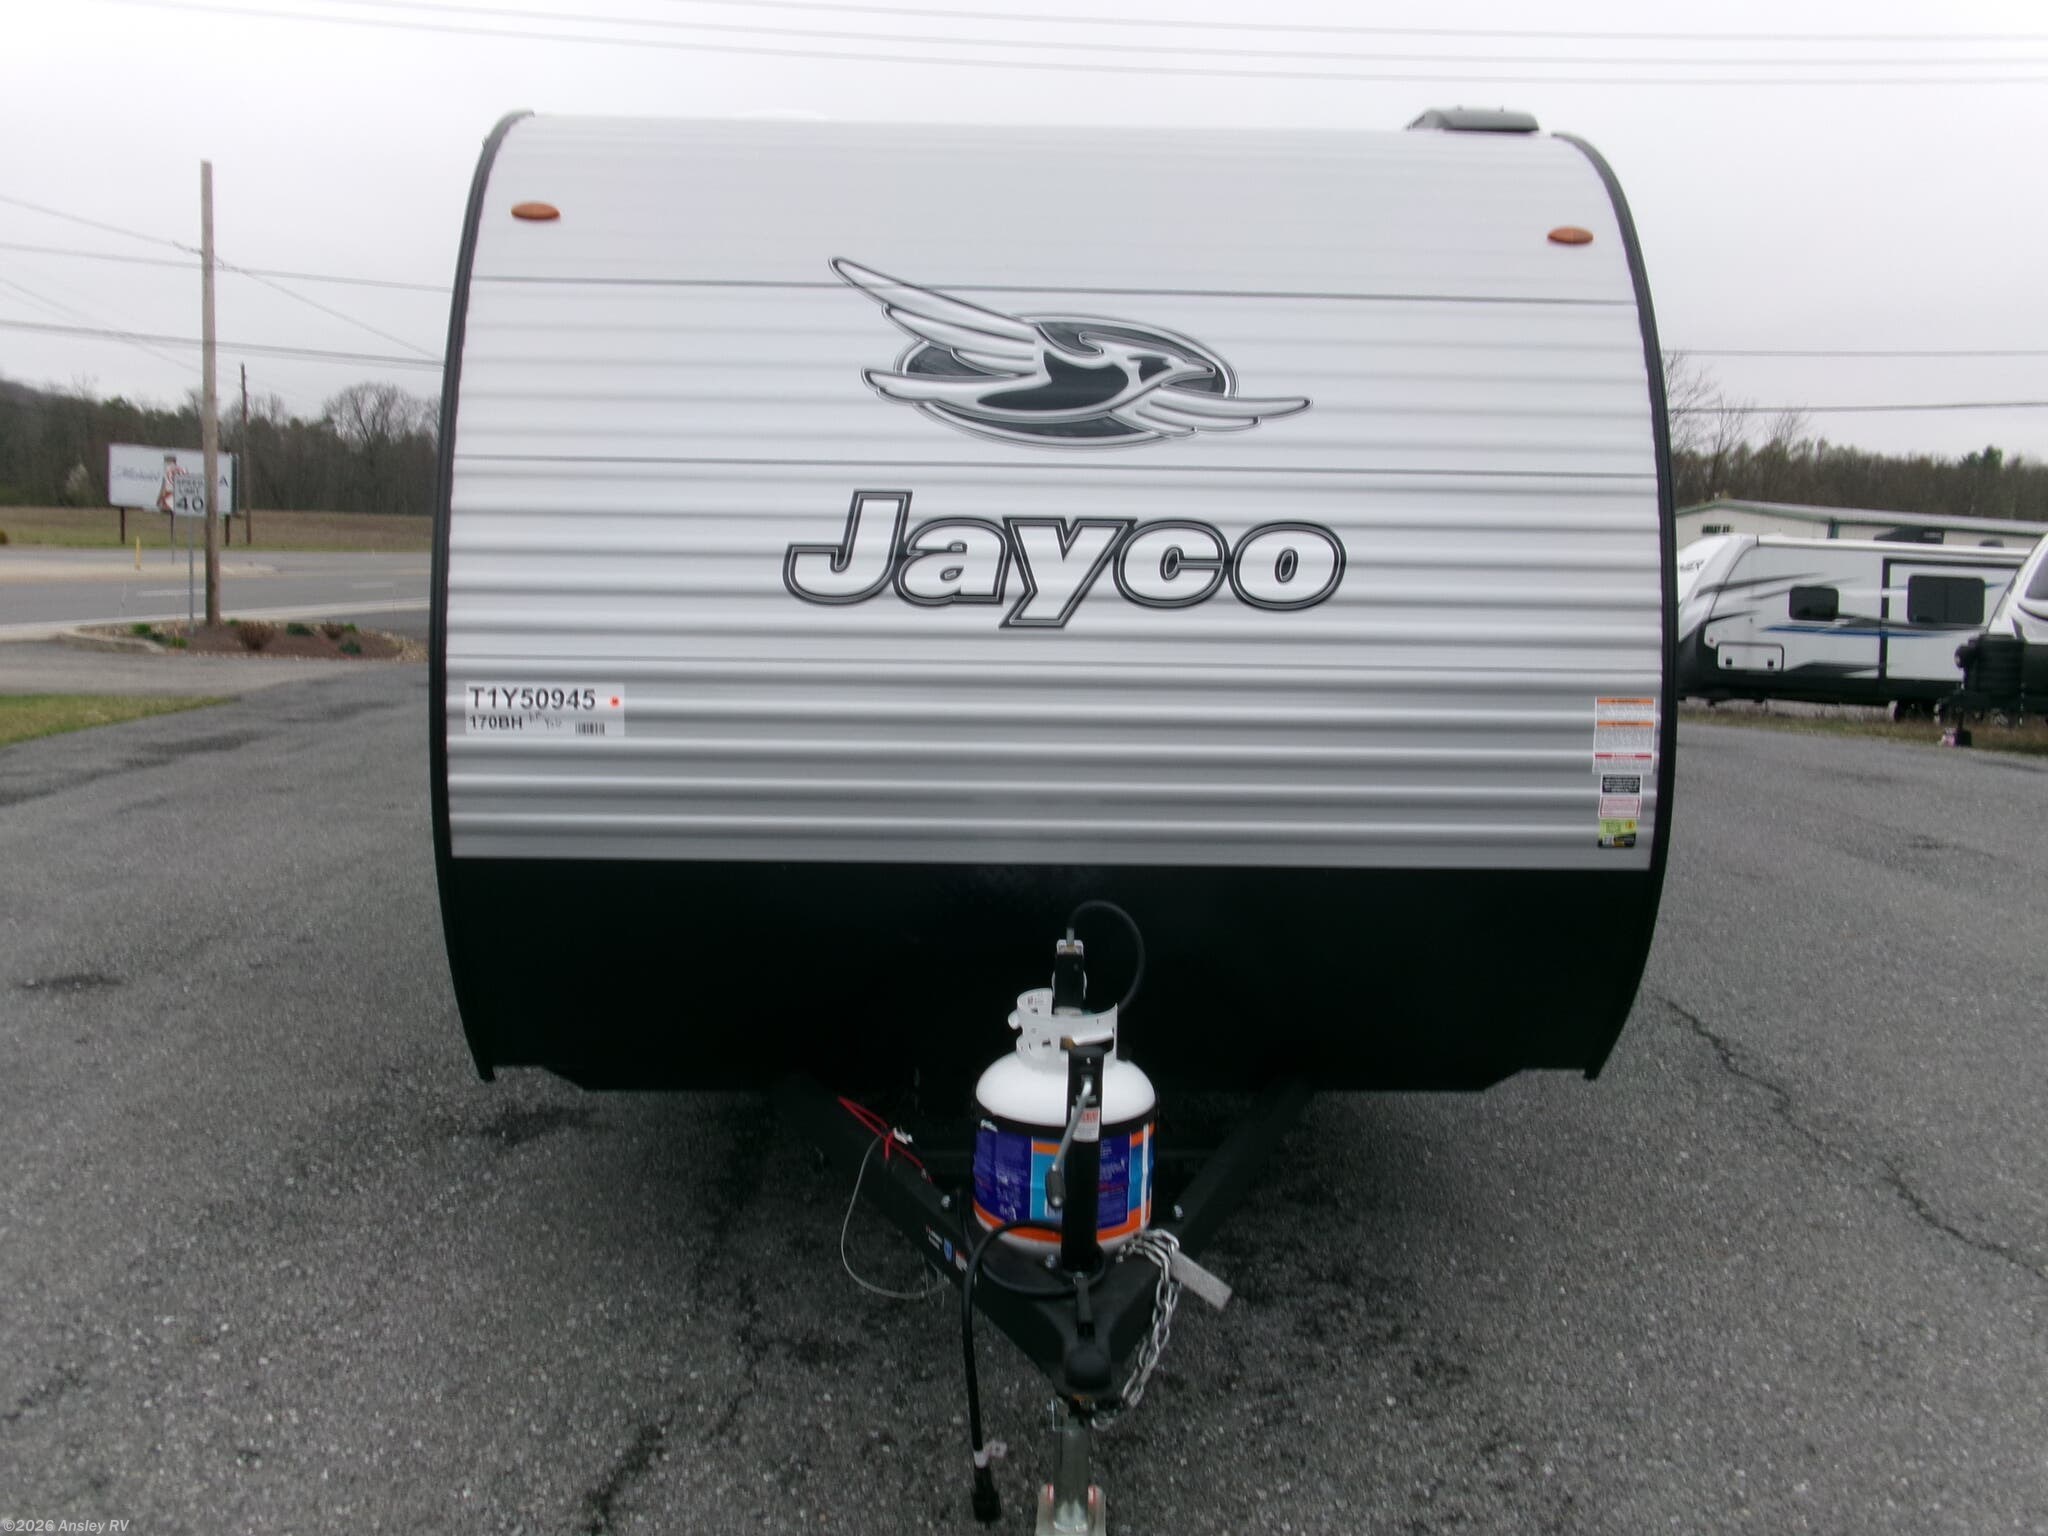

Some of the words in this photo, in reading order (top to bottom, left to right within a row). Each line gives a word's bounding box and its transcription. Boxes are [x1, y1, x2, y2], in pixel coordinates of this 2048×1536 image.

[175, 496, 204, 512] 40
[783, 489, 1346, 629] Jayco
[469, 687, 595, 710] T1Y50945
[470, 714, 523, 731] 170BH
